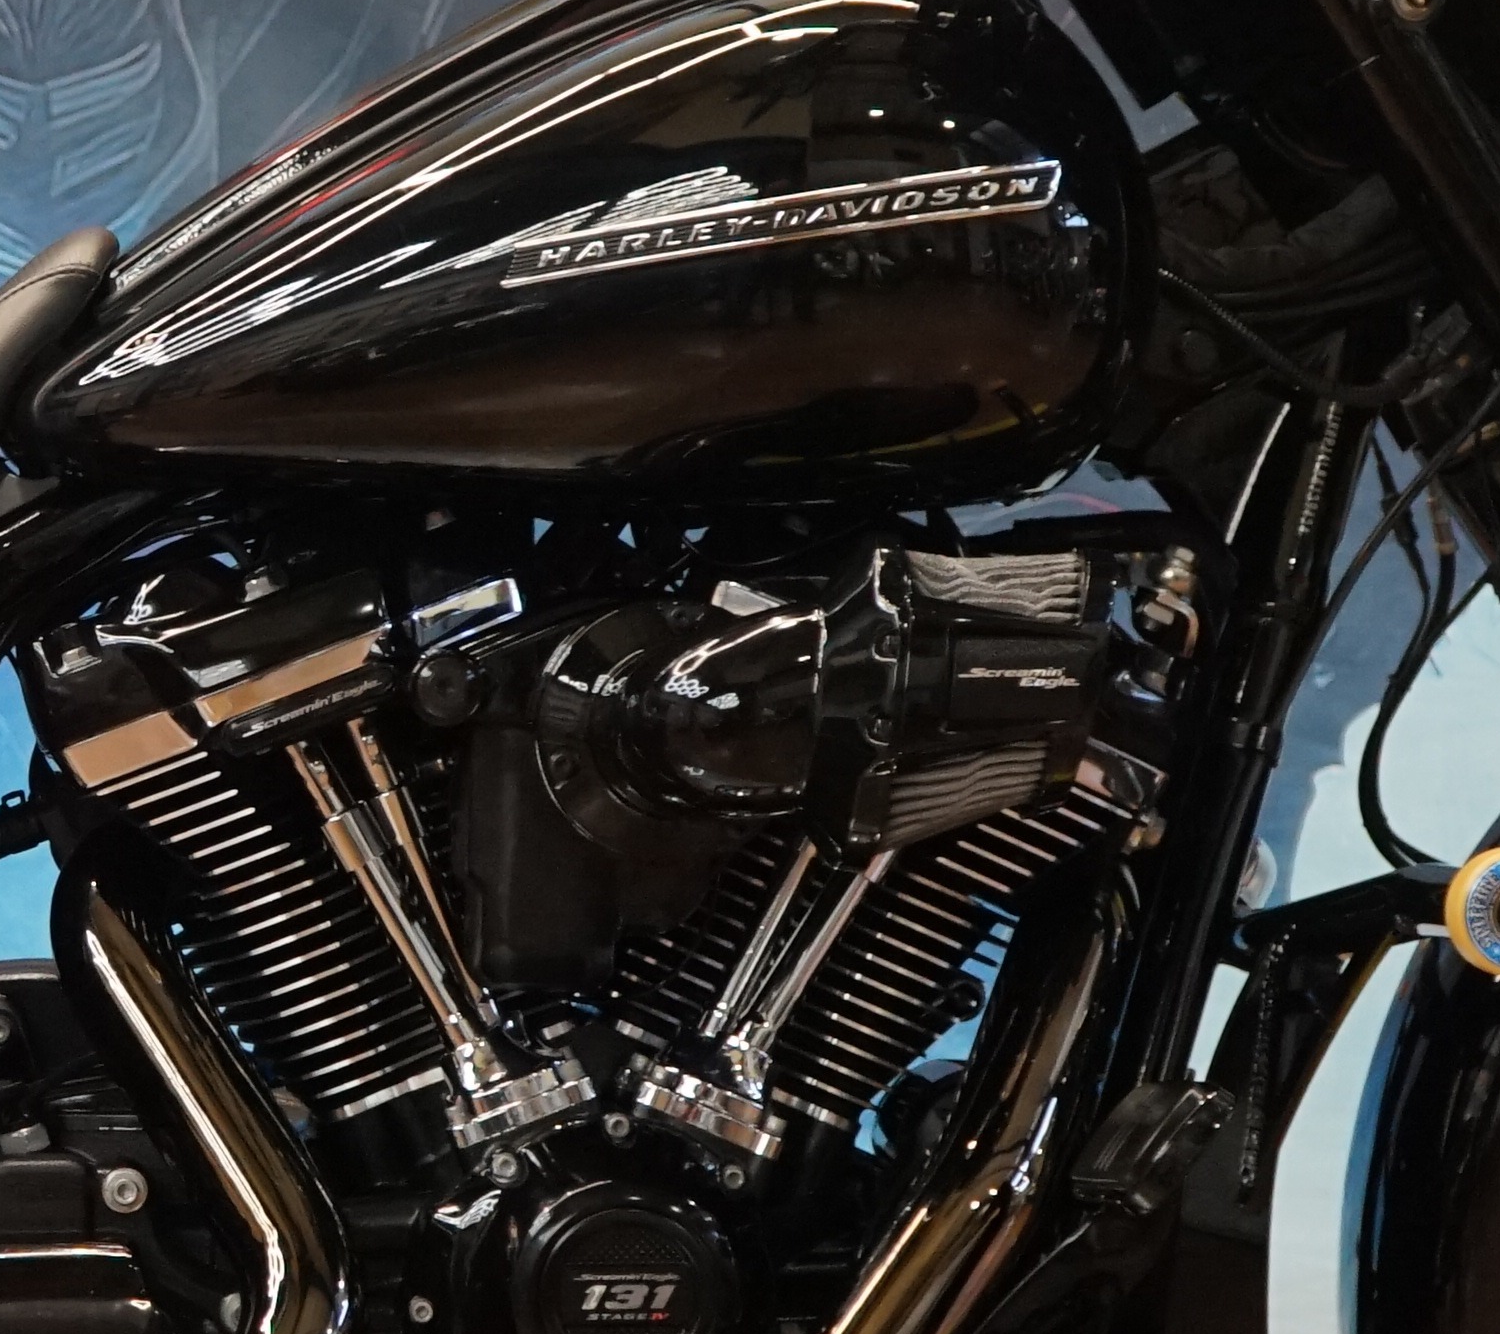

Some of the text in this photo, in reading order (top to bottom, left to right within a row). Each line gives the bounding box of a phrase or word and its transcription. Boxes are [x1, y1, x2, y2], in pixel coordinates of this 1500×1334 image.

[538, 174, 1040, 270] HARLEY-DAVIDSON
[1019, 675, 1081, 689] Eagle
[581, 1284, 677, 1310] 131
[585, 1313, 648, 1321] STAGE
